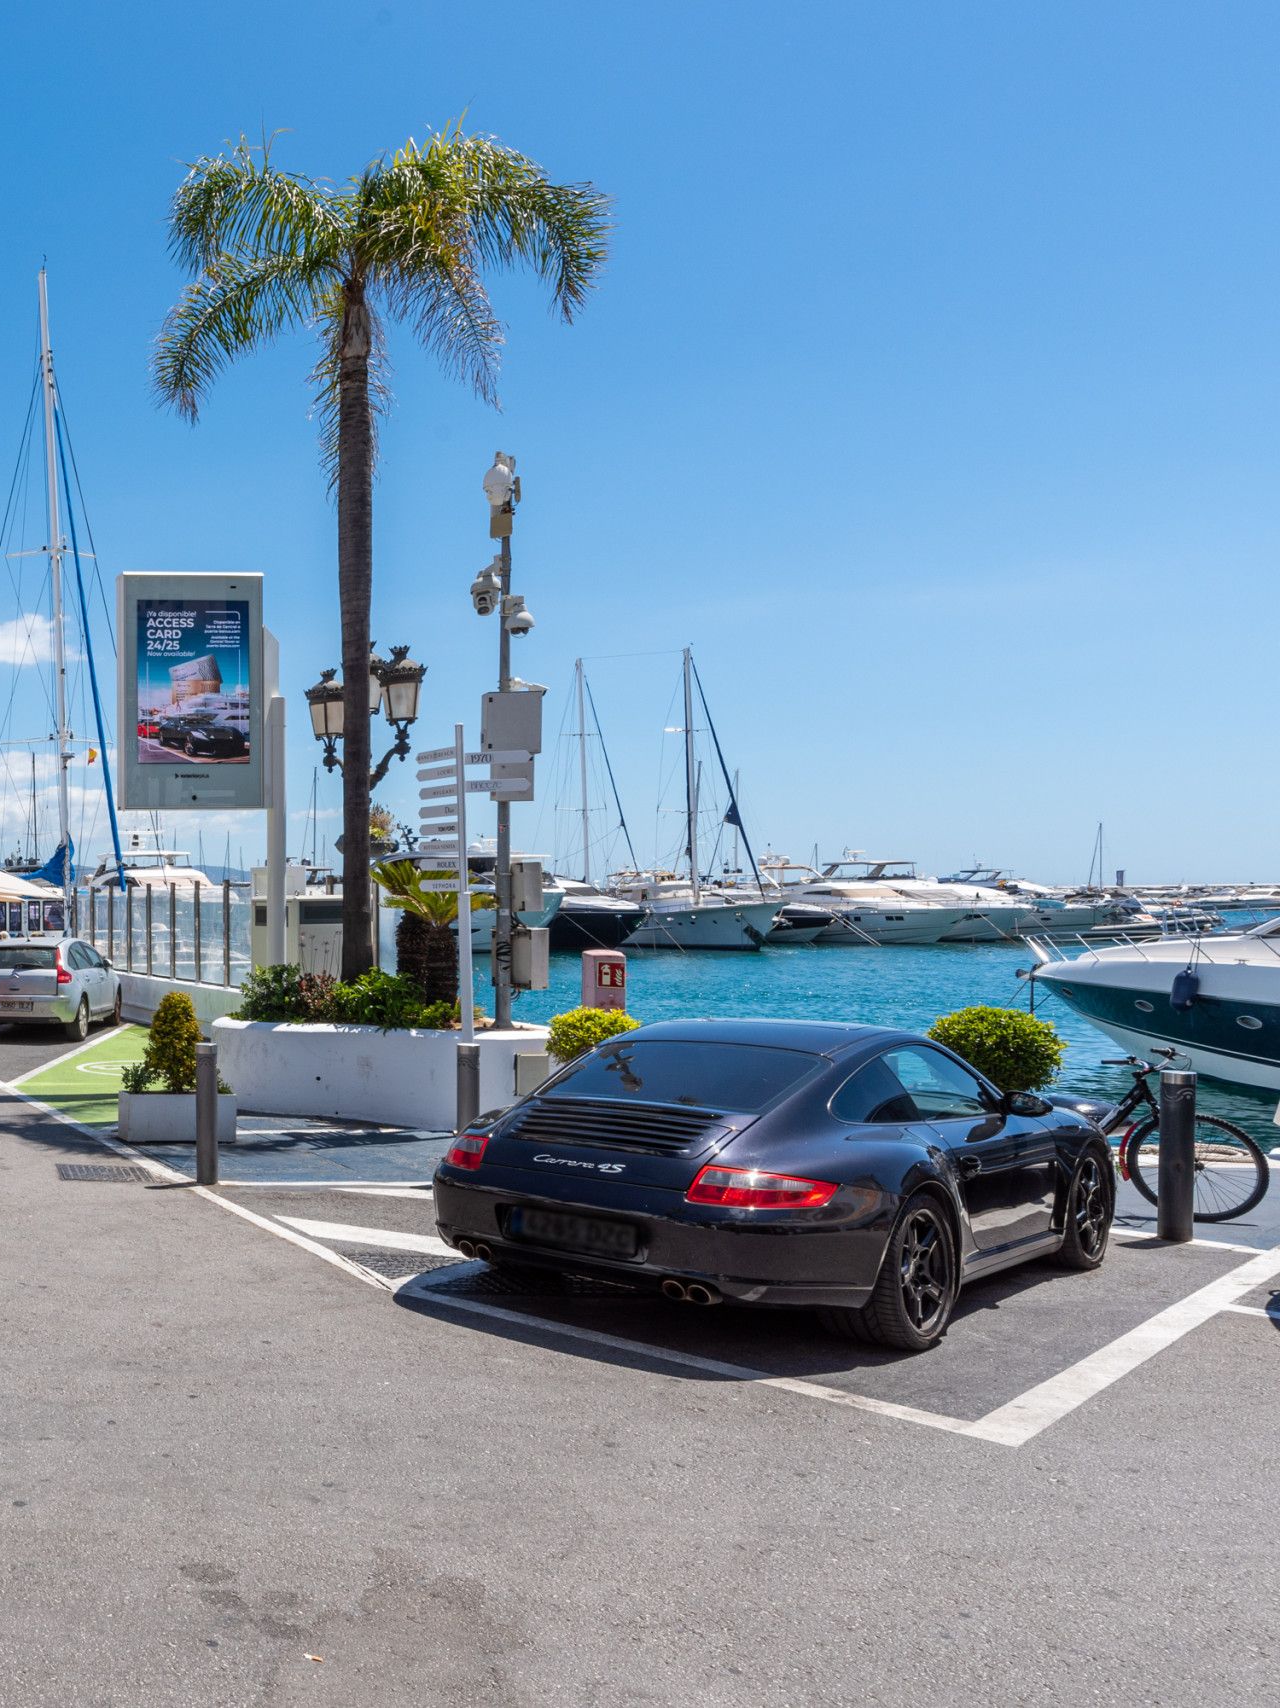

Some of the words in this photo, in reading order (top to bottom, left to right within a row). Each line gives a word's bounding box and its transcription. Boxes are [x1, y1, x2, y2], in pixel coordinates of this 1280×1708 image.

[146, 618, 194, 628] ACCESS
[146, 629, 182, 639] CARD
[146, 639, 180, 651] 24/25
[533, 1154, 595, 1169] Carrera
[597, 1163, 626, 1174] 4S
